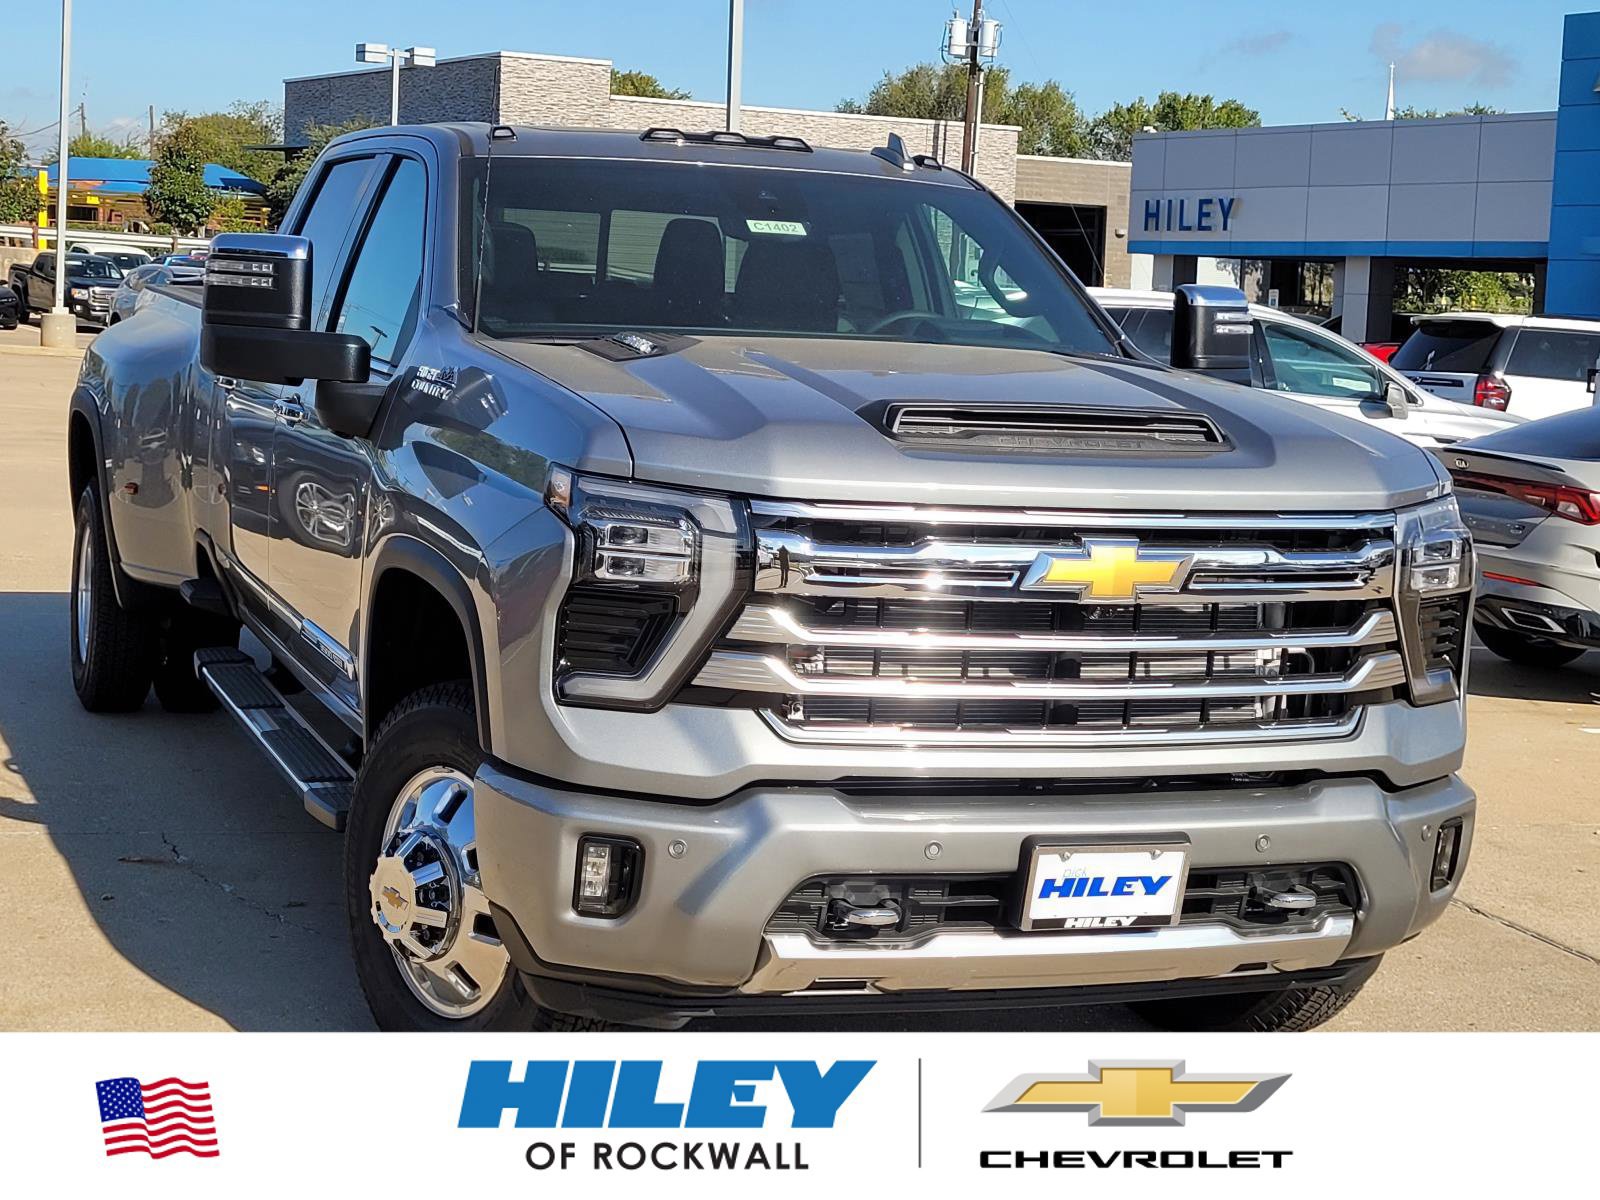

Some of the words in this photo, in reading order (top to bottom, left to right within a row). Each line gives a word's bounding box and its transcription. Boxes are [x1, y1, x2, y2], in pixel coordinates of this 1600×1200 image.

[1143, 198, 1235, 232] HILEY
[753, 222, 799, 233] C1402
[998, 436, 1144, 449] CHEVROLET
[1038, 875, 1173, 899] HILEY
[1064, 916, 1138, 929] HILEY
